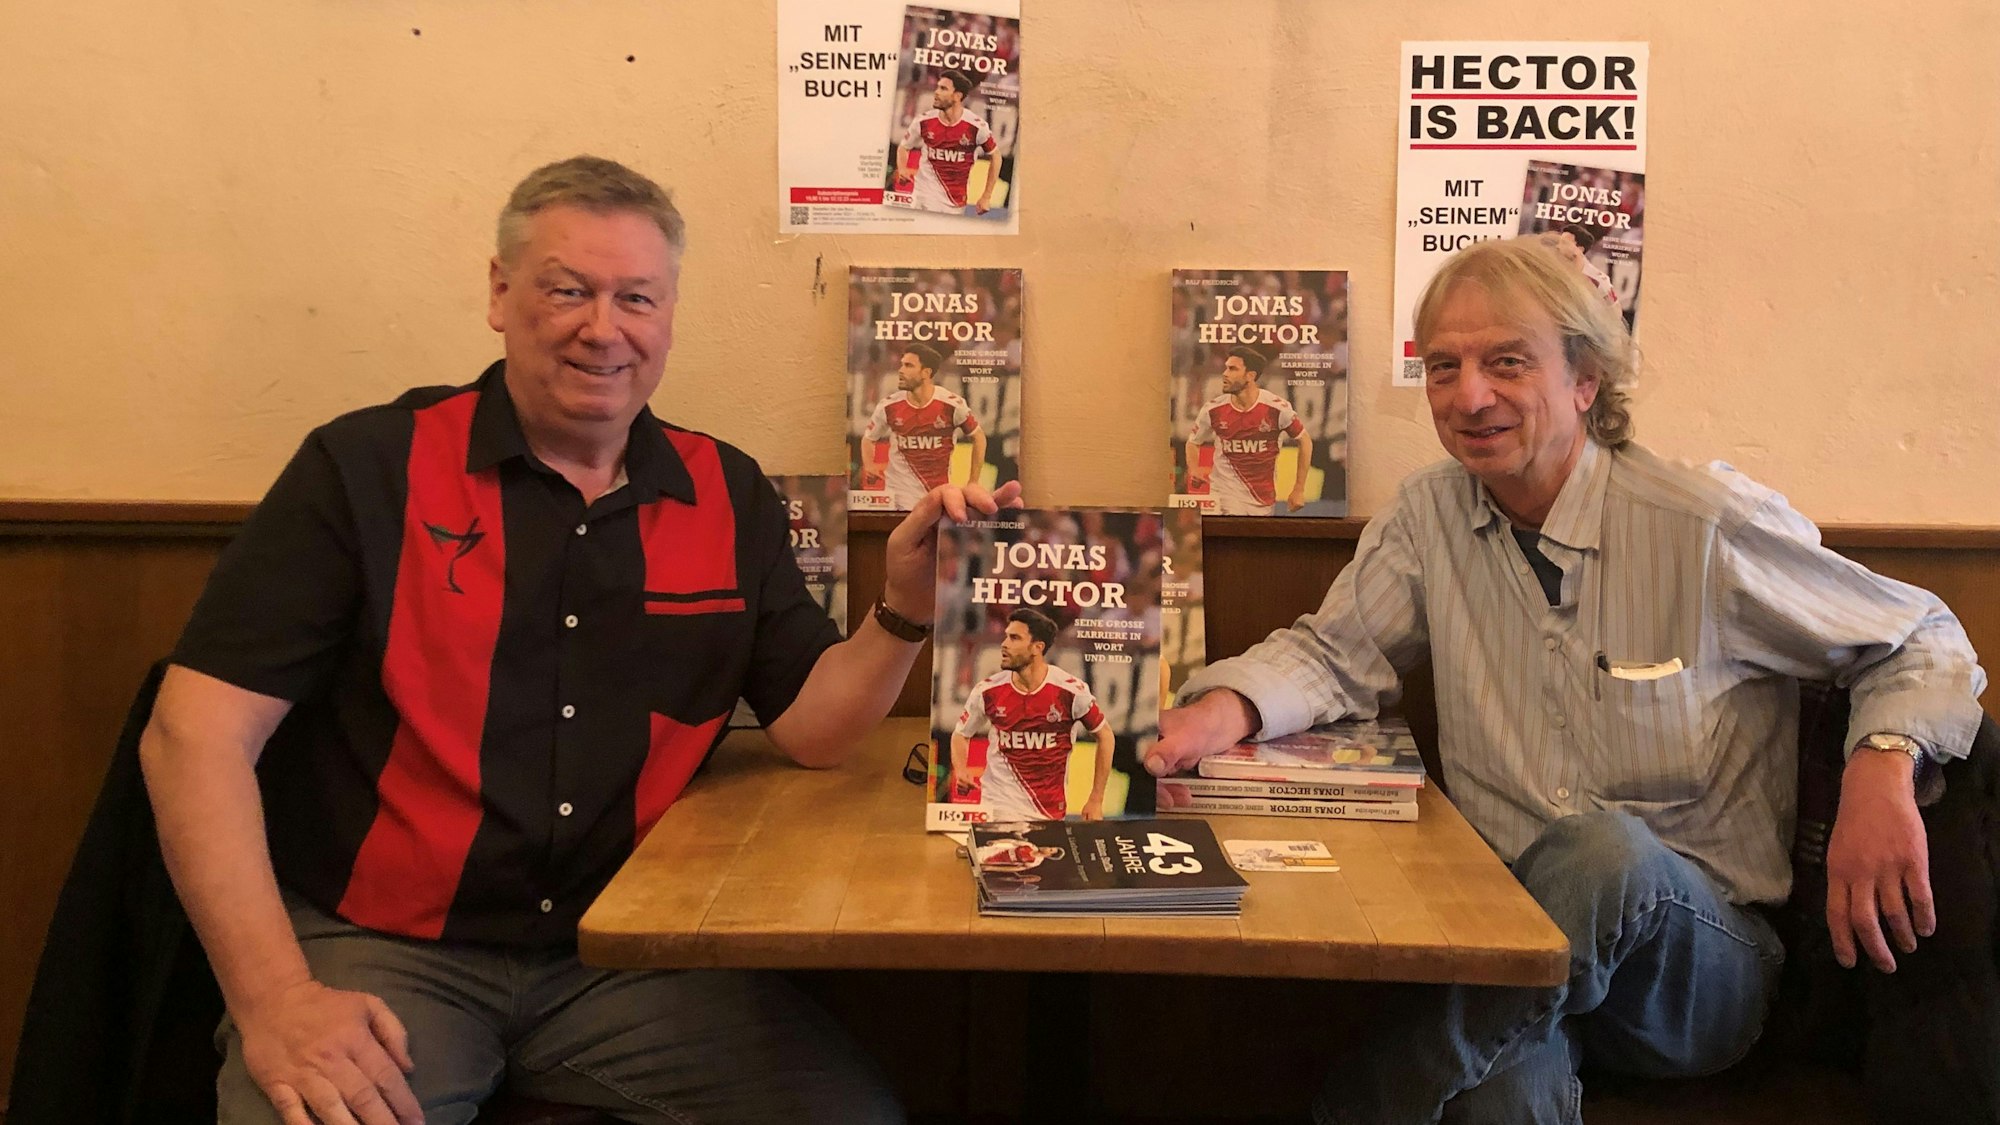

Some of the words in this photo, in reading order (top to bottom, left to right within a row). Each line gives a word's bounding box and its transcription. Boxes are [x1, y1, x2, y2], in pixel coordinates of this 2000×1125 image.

[824, 25, 862, 42] MIT
[927, 28, 998, 52] JONAS
[913, 48, 1008, 76] HECTOR
[1411, 55, 1637, 90] HECTOR
[804, 80, 868, 98] BUCH
[877, 80, 882, 98] !
[1410, 104, 1457, 140] IS
[1477, 105, 1635, 140] BACK!
[927, 148, 966, 163] REWE
[1445, 180, 1484, 197] MIT
[1550, 182, 1622, 206] JONAS
[1535, 202, 1632, 230] HECTOR
[890, 292, 978, 317] JONAS
[1214, 295, 1304, 320] JONAS
[874, 320, 994, 342] HECTOR
[1198, 324, 1320, 344] HECTOR
[1294, 370, 1318, 378] WORT
[898, 436, 942, 450] REWE
[1223, 439, 1268, 454] REWE
[978, 520, 1024, 530] FRIEDRICHS
[992, 542, 1106, 574] JONAS
[972, 578, 1127, 608] HECTOR
[1074, 618, 1104, 628] SEINE
[1106, 619, 1144, 628] GROSSE
[1076, 630, 1128, 640] KARRIERE
[1130, 632, 1142, 640] IN
[1094, 642, 1124, 652] WORT
[1084, 654, 1106, 662] UND
[1108, 654, 1132, 664] BILD
[999, 729, 1057, 750] REWE
[1269, 786, 1310, 795] HECTOR
[1314, 787, 1344, 796] JONAS
[1270, 805, 1312, 814] HECTOR
[1314, 806, 1346, 814] JONAS
[1114, 836, 1146, 874] JAHRE
[1142, 832, 1202, 876] 43
